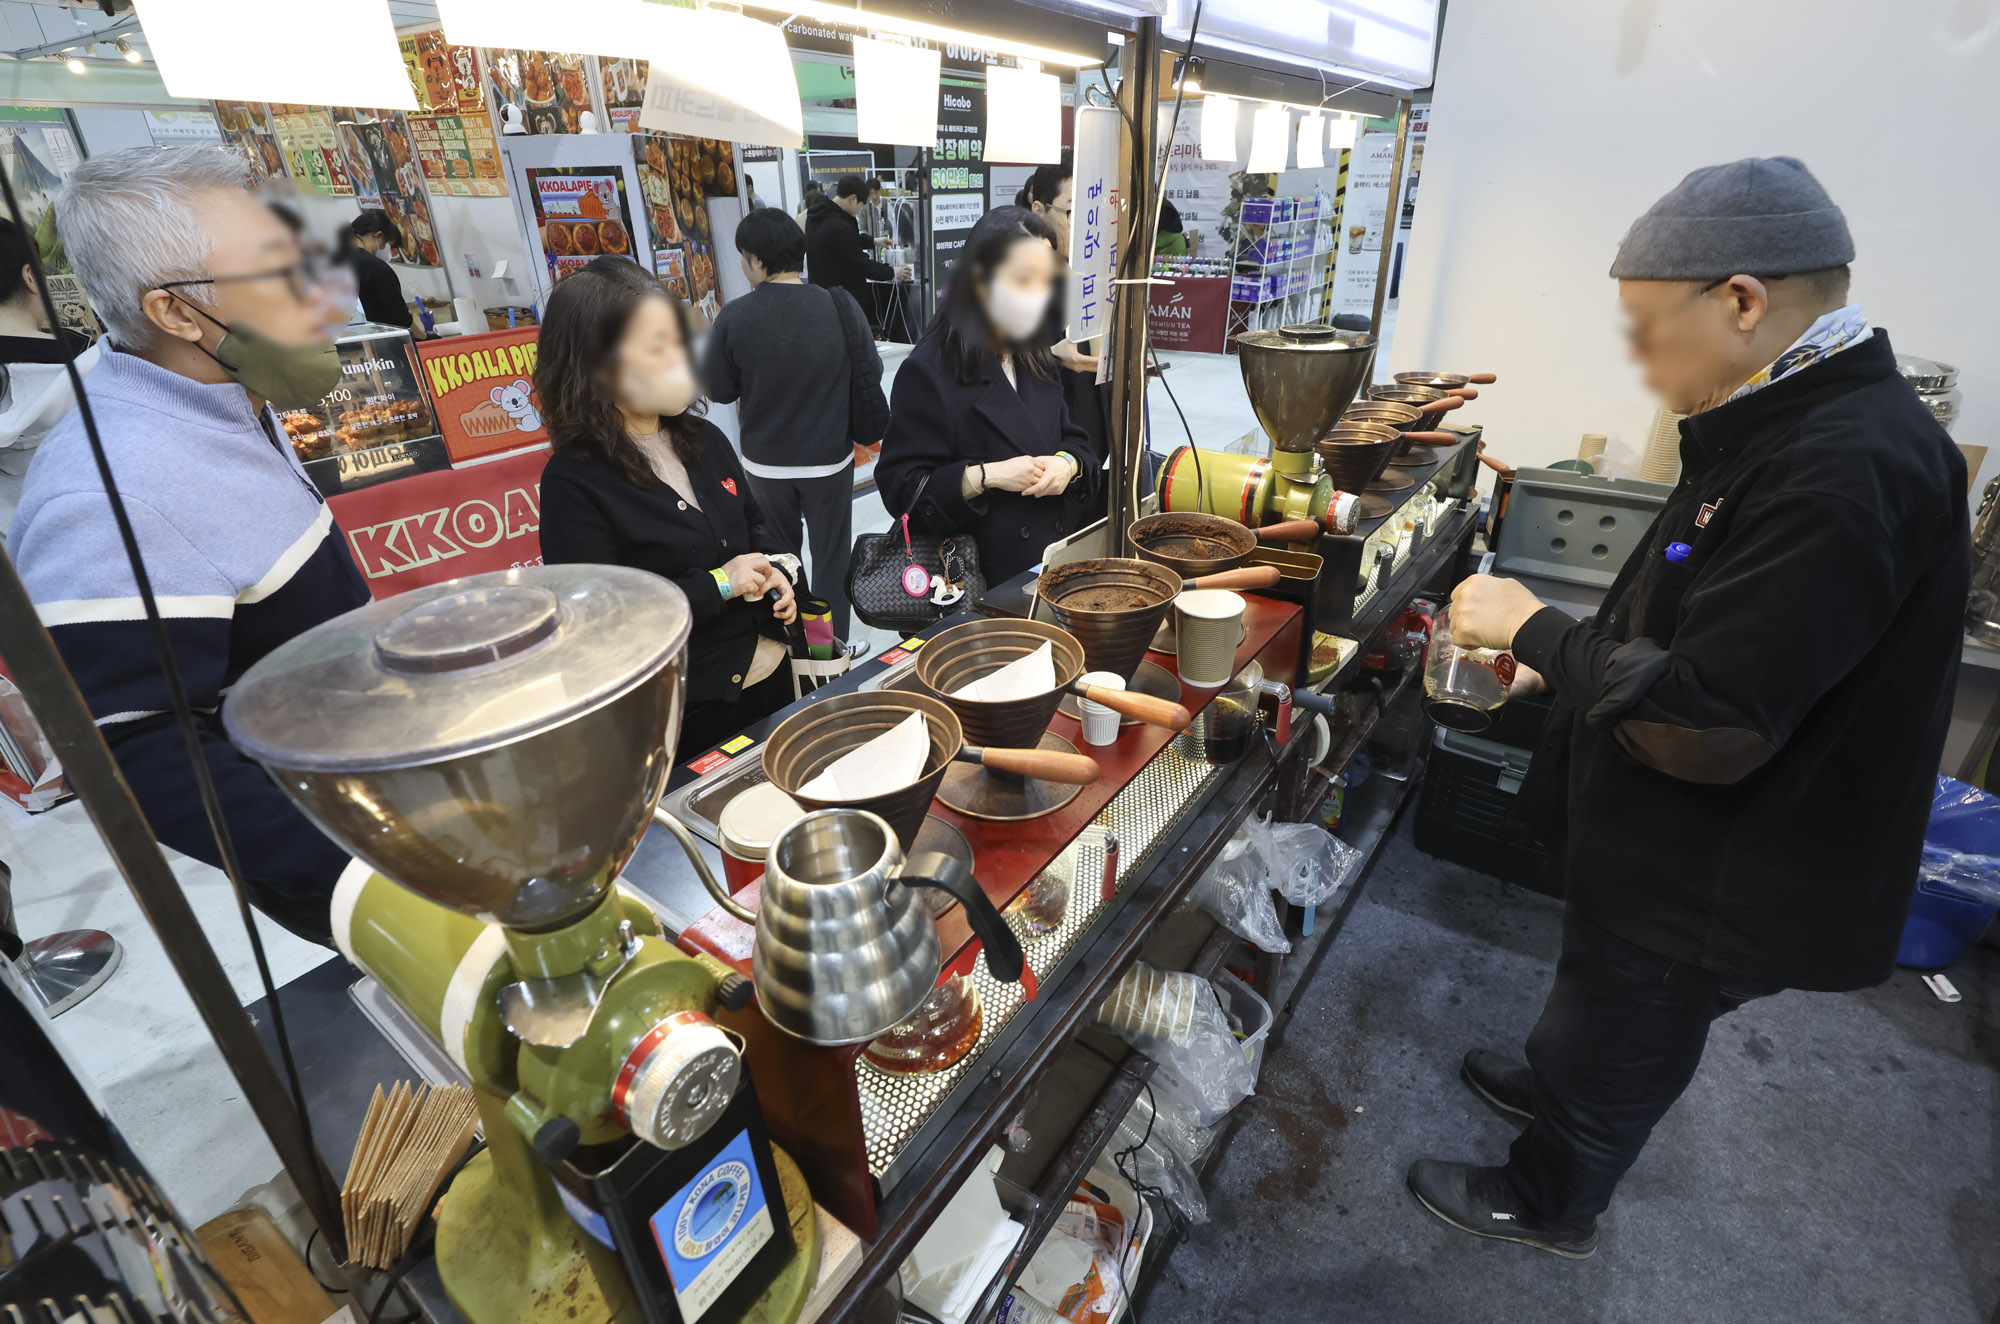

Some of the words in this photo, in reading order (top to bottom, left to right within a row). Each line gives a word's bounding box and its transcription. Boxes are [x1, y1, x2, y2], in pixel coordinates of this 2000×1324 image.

[787, 24, 836, 40] carbonated
[838, 33, 854, 42] wat
[944, 94, 971, 109] Hicabo
[538, 180, 593, 192] KKOALAPIE
[931, 168, 968, 189] 50만원
[1176, 190, 1183, 198] 티
[1084, 178, 1103, 260] 맛으로
[1080, 273, 1097, 331] 커피
[1148, 304, 1192, 319] AMAN
[425, 349, 511, 397] KKOALA
[508, 342, 539, 376] PIE
[348, 484, 542, 579] KKOA
[677, 1207, 691, 1241] 100%
[689, 1174, 715, 1205] KONA
[716, 1163, 746, 1181] COFFEE
